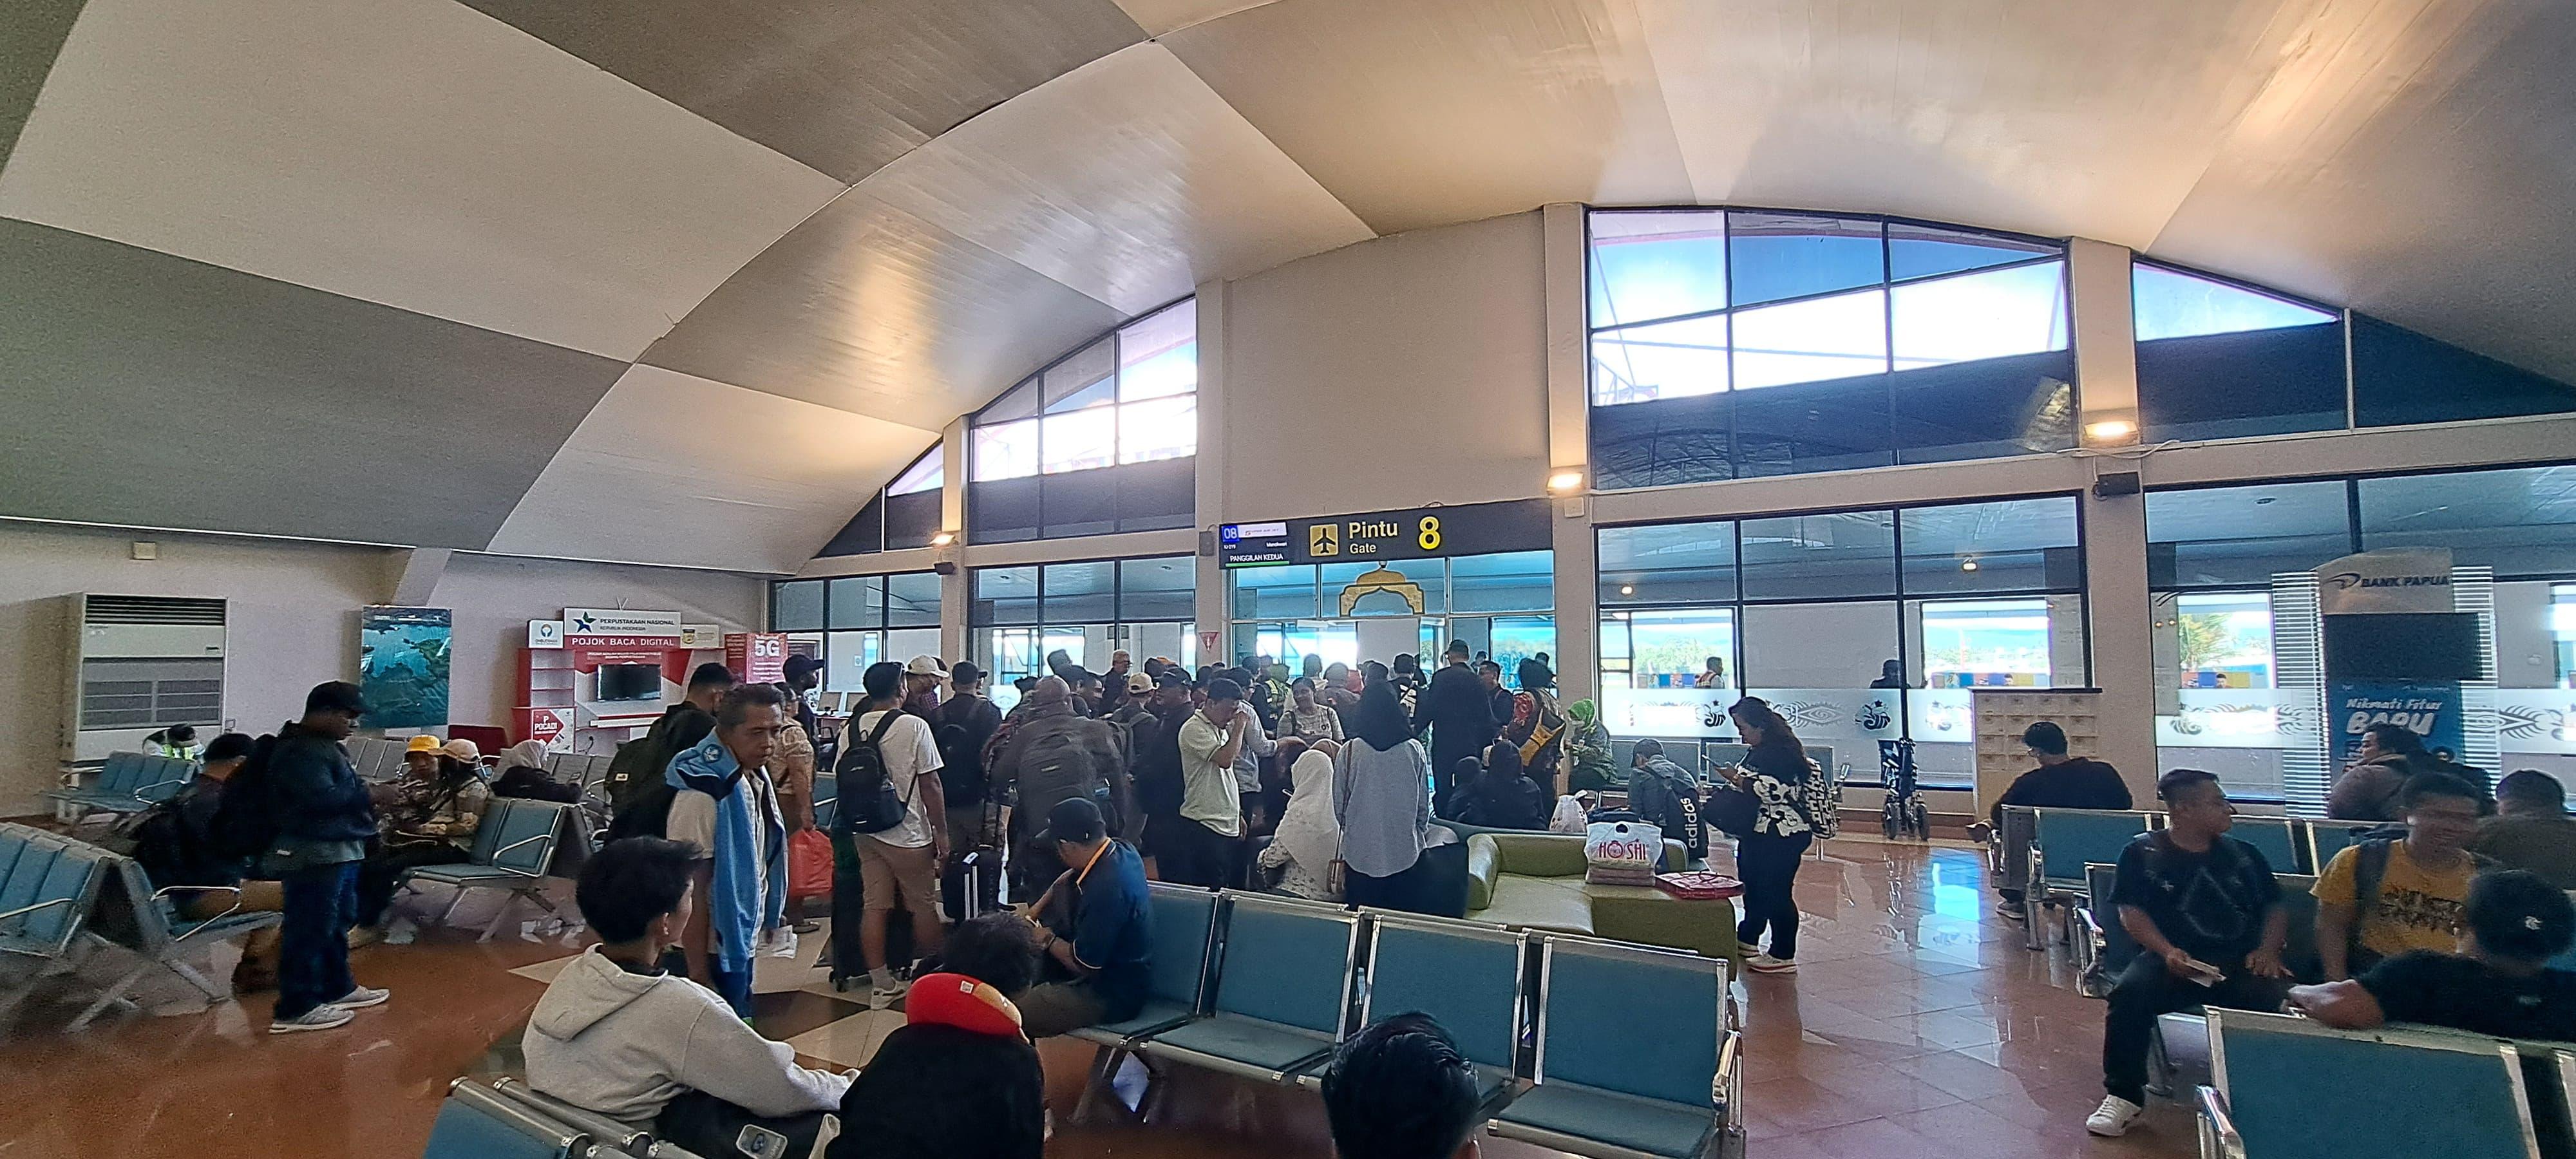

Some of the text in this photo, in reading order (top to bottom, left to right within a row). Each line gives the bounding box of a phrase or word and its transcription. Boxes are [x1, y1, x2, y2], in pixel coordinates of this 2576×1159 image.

[1224, 528, 1237, 539] 08
[1349, 516, 1441, 549] Pintu 8
[1350, 543, 1377, 554] Gate
[2362, 576, 2450, 587] BANK PAPUA
[755, 640, 780, 657] 5G
[1680, 798, 1698, 849] adidas
[1599, 840, 1646, 860] HOSHI
